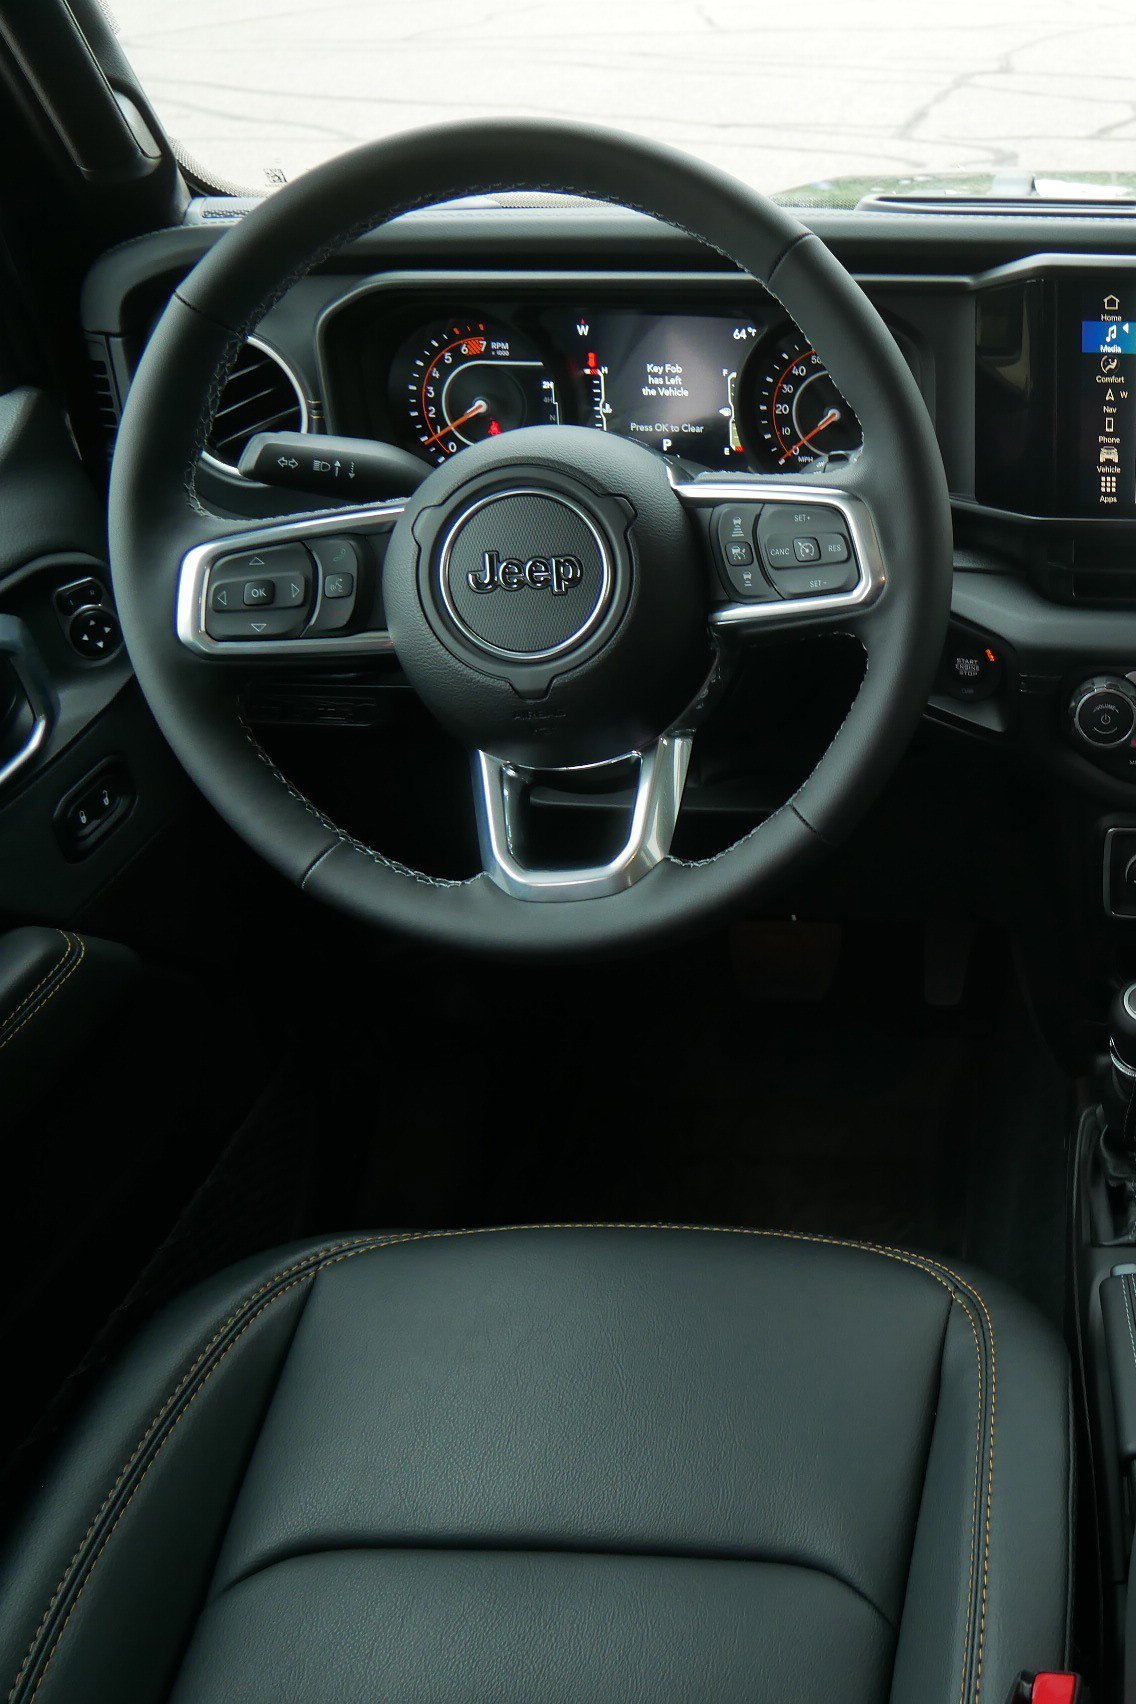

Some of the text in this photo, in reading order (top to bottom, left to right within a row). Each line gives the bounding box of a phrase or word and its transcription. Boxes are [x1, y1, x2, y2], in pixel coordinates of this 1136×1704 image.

[1100, 313, 1122, 322] Home
[577, 325, 589, 336] W
[461, 344, 468, 354] 6
[480, 340, 487, 352] 7
[491, 342, 509, 350] RPM
[1100, 345, 1122, 353] Media
[444, 353, 453, 364] 5
[432, 368, 440, 379] 4
[646, 364, 683, 375] Key Fob
[792, 366, 807, 377] 40
[648, 375, 683, 385] has Left
[1096, 375, 1125, 384] Comfort
[427, 386, 435, 398] 3
[642, 386, 689, 397] the Vehicle
[782, 385, 794, 394] 30
[1120, 391, 1128, 399] W
[428, 406, 436, 418] 2
[775, 404, 790, 415] 20
[1103, 406, 1117, 414] Nav
[630, 423, 704, 433] Press OK to Clear
[782, 427, 791, 436] 10
[1098, 435, 1121, 444] Phone
[448, 442, 457, 452] 0
[662, 439, 672, 451] P
[724, 447, 730, 456] E
[1096, 466, 1121, 474] Vehicle
[1100, 496, 1118, 504] Apps
[770, 548, 790, 556] CANC
[828, 544, 842, 552] RES
[467, 550, 584, 597] Jeep
[251, 587, 268, 598] OK
